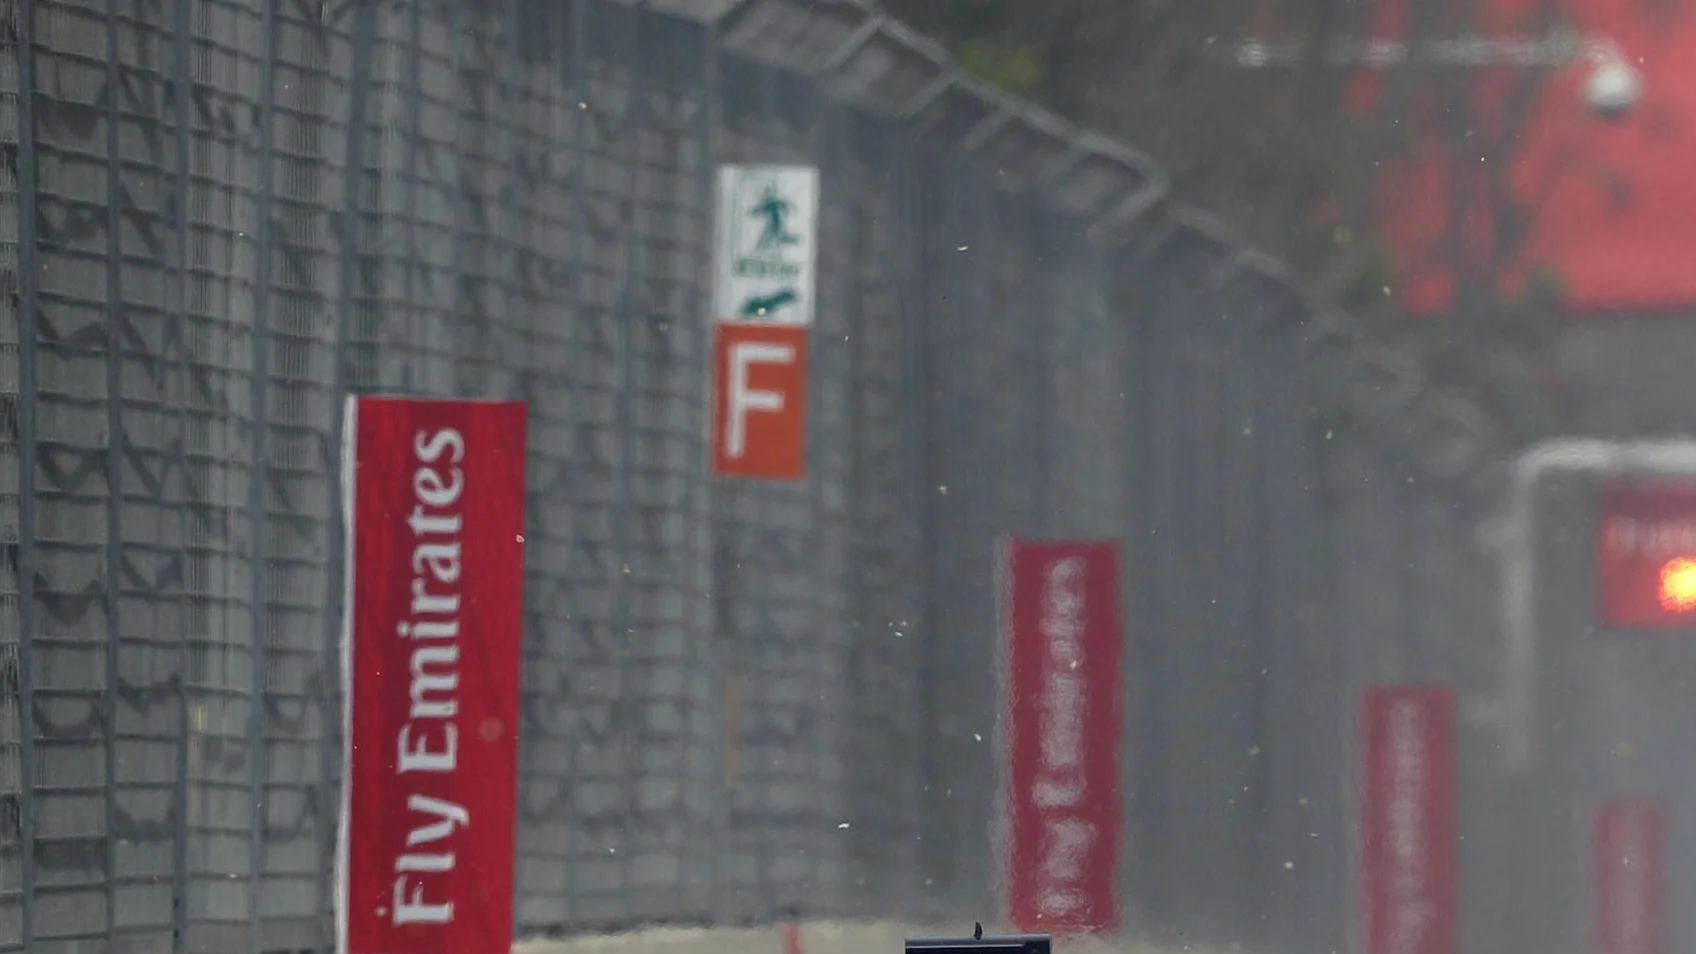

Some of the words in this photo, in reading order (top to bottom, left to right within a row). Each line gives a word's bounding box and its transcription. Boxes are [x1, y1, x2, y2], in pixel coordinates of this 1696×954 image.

[727, 342, 796, 459] F
[398, 427, 465, 773] Emirates
[393, 795, 469, 924] Fly
